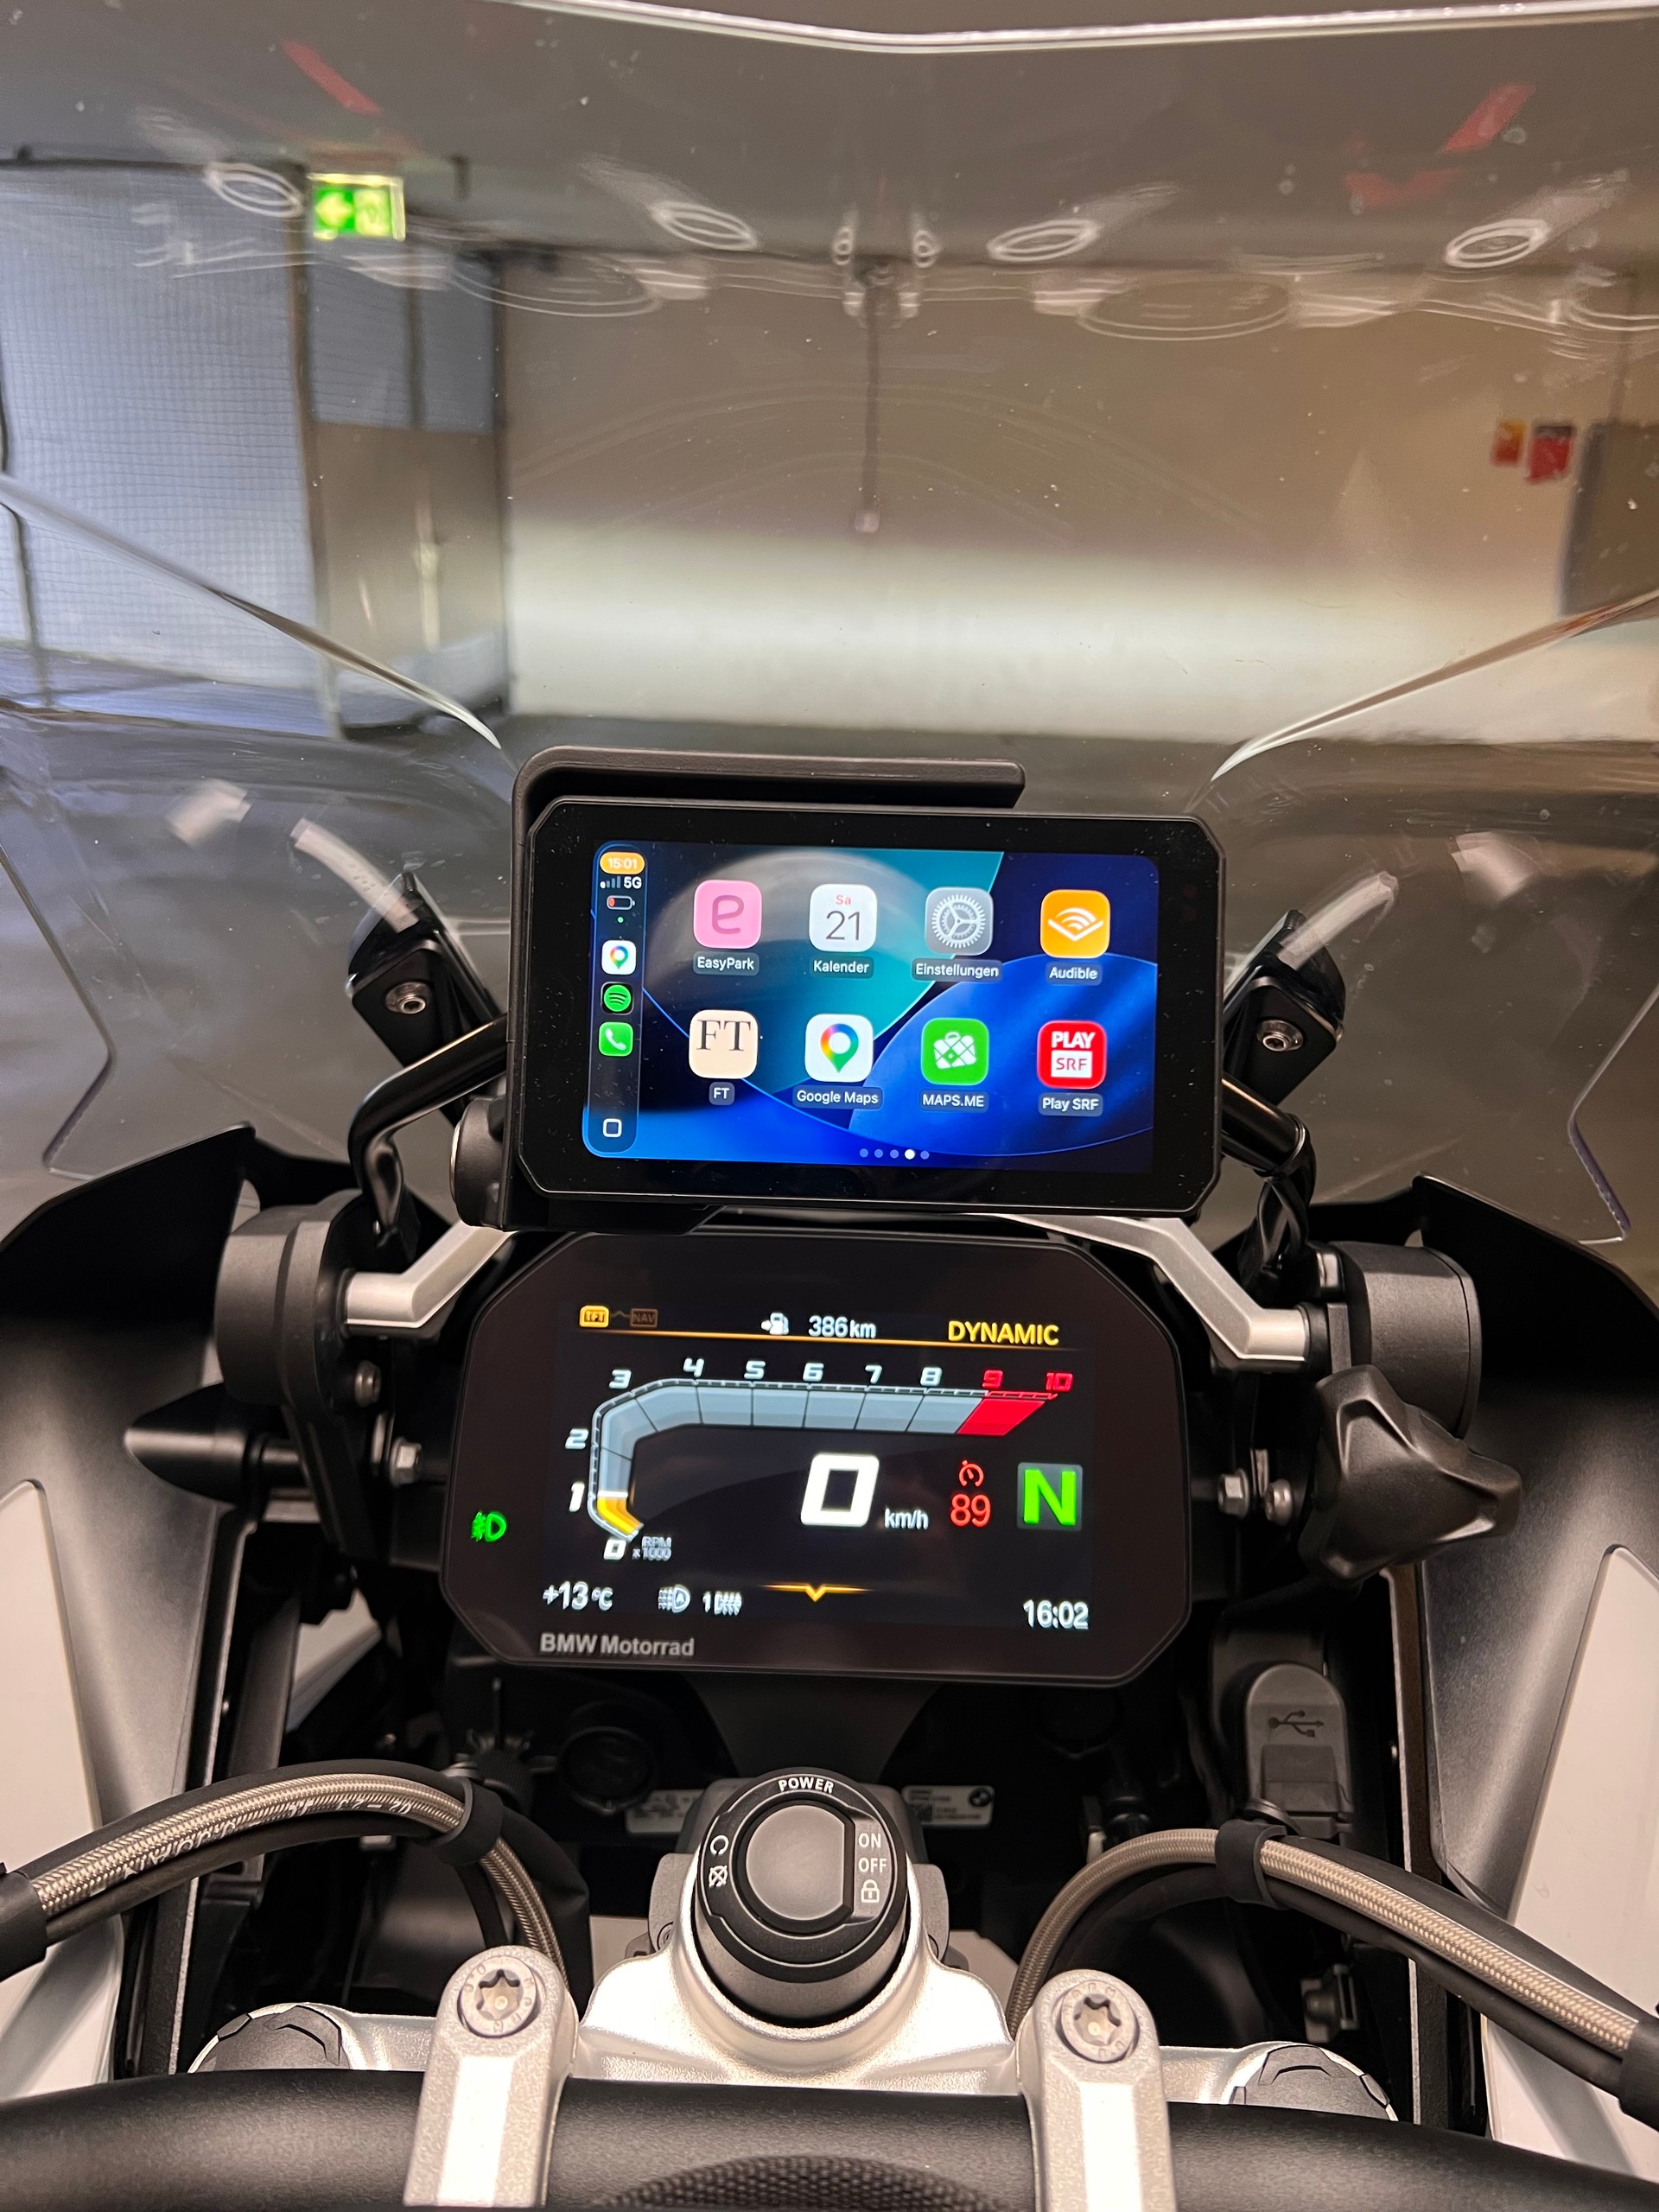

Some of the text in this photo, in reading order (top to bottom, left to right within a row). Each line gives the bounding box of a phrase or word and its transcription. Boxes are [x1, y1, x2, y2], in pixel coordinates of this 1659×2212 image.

[607, 857, 637, 869] 15:01
[623, 877, 642, 889] 5G
[836, 895, 851, 906] Sa
[825, 911, 861, 941] 21
[696, 956, 755, 971] EasyPark
[813, 960, 870, 974] Kalender
[915, 963, 999, 978] Einstellungen
[1049, 967, 1097, 980] Audible
[696, 1020, 751, 1052] FT
[1051, 1031, 1096, 1049] PLAY
[1056, 1058, 1088, 1071] SRF
[713, 1088, 729, 1099] FT
[797, 1090, 879, 1107] Google Maps
[922, 1094, 984, 1108] MAPS.ME
[1042, 1097, 1099, 1112] Play SRF
[632, 1313, 656, 1324] NAV
[949, 1321, 1059, 1346] DYNAMIC
[683, 1357, 705, 1377] 4
[745, 1360, 766, 1380] 5
[803, 1363, 824, 1382] 6
[865, 1365, 882, 1384] 7
[608, 1369, 632, 1389] 3
[920, 1367, 943, 1387] 8
[982, 1370, 1004, 1389] 9
[1046, 1372, 1073, 1392] 10
[565, 1428, 588, 1450] 2
[569, 1481, 586, 1513] 1
[800, 1452, 930, 1529] 0 km/h
[1023, 1468, 1077, 1527] N
[950, 1493, 992, 1528] 89
[604, 1539, 626, 1560] 0
[642, 1536, 671, 1548] RPM
[1023, 1599, 1089, 1630] 16:02
[539, 1631, 695, 1657] BMW Motorrad
[779, 1777, 834, 1794] POWER
[858, 1833, 881, 1848] ON
[858, 1857, 887, 1873] OFF
